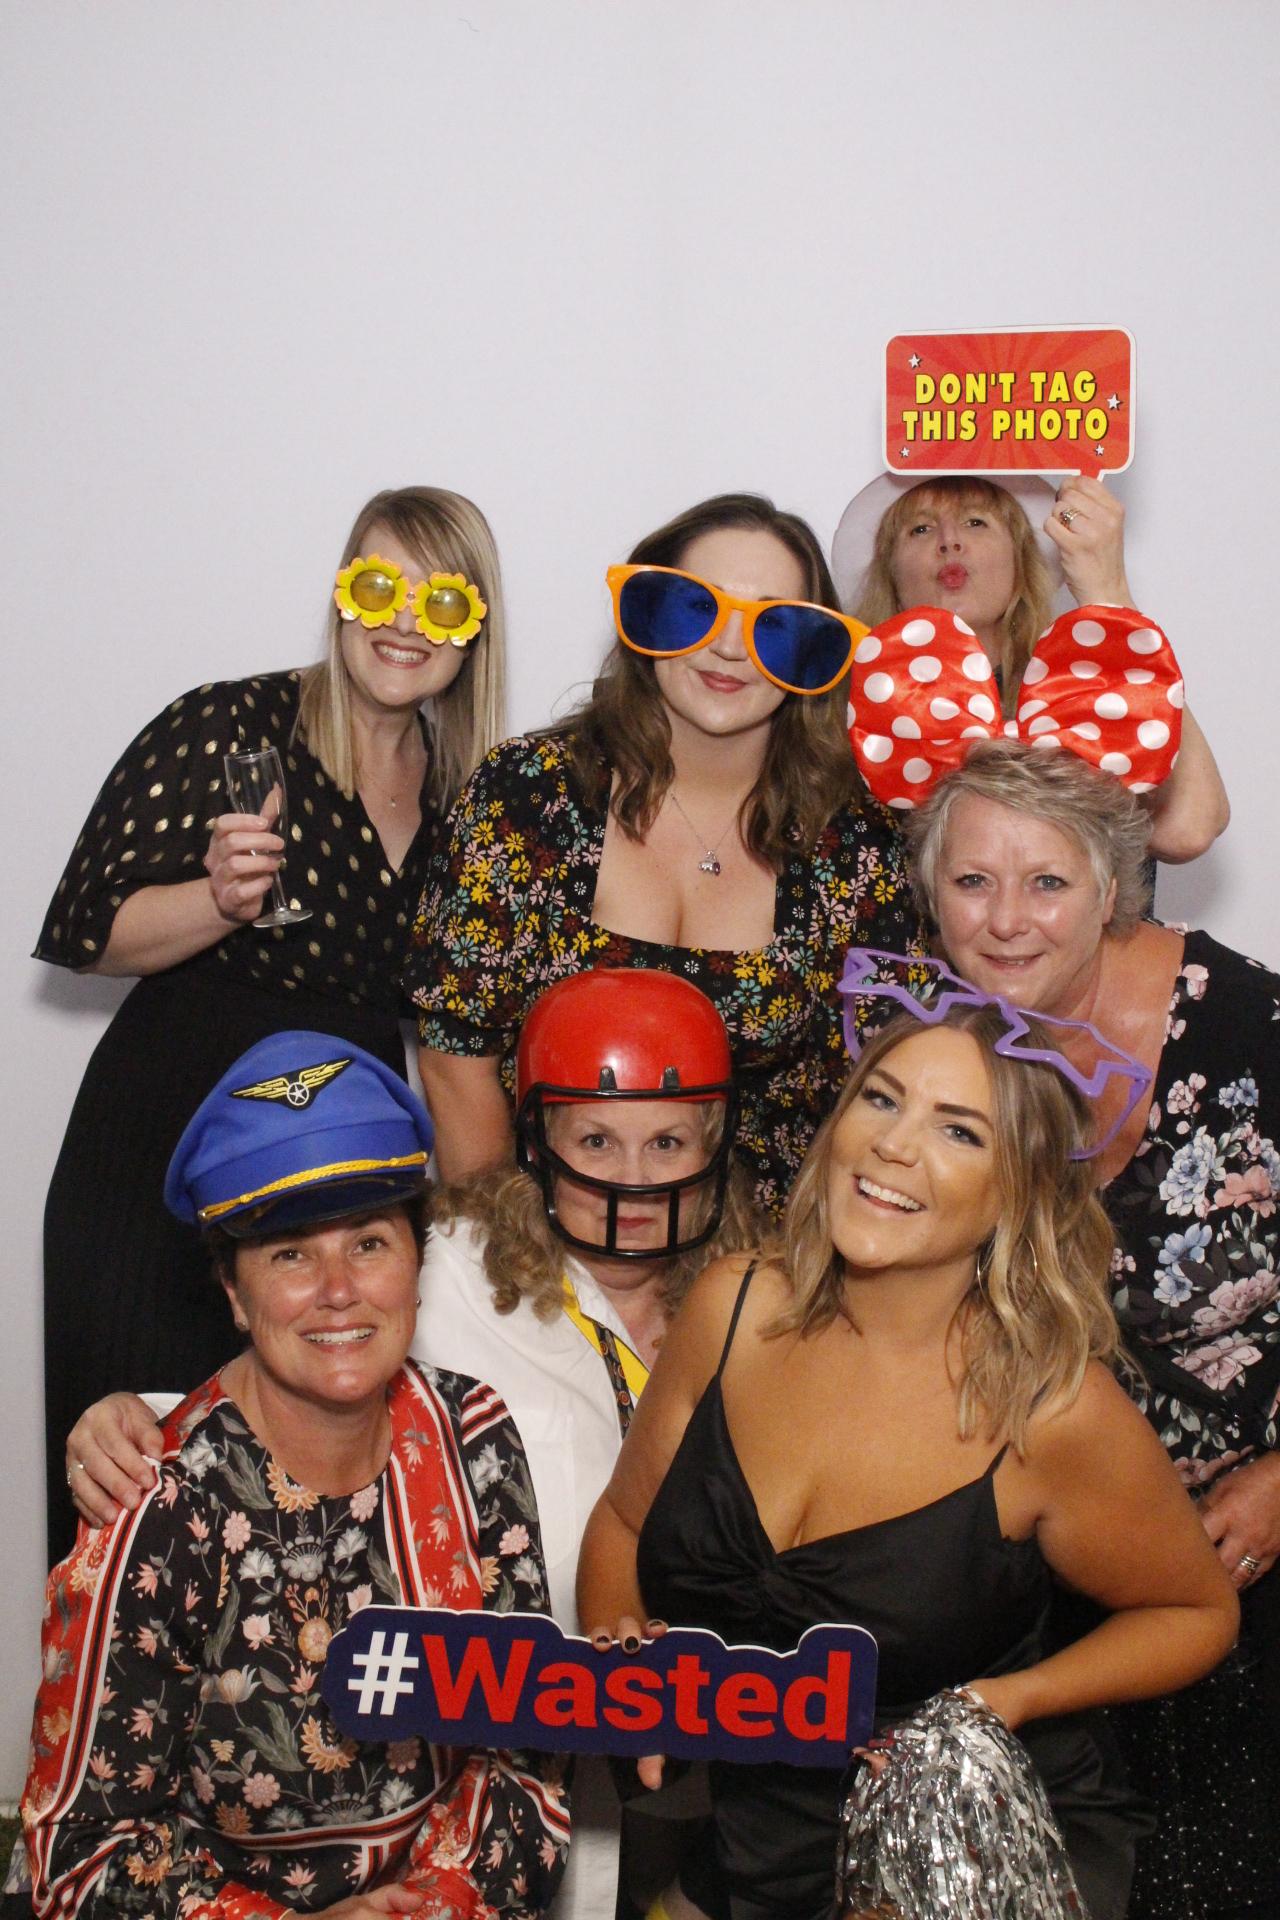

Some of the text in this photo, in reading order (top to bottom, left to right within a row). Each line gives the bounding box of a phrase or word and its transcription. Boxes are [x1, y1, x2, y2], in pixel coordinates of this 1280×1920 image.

[915, 370, 1096, 404] DON'T TAG
[902, 407, 1108, 441] THIS PHOTO
[347, 1630, 852, 1742] #Wasted
